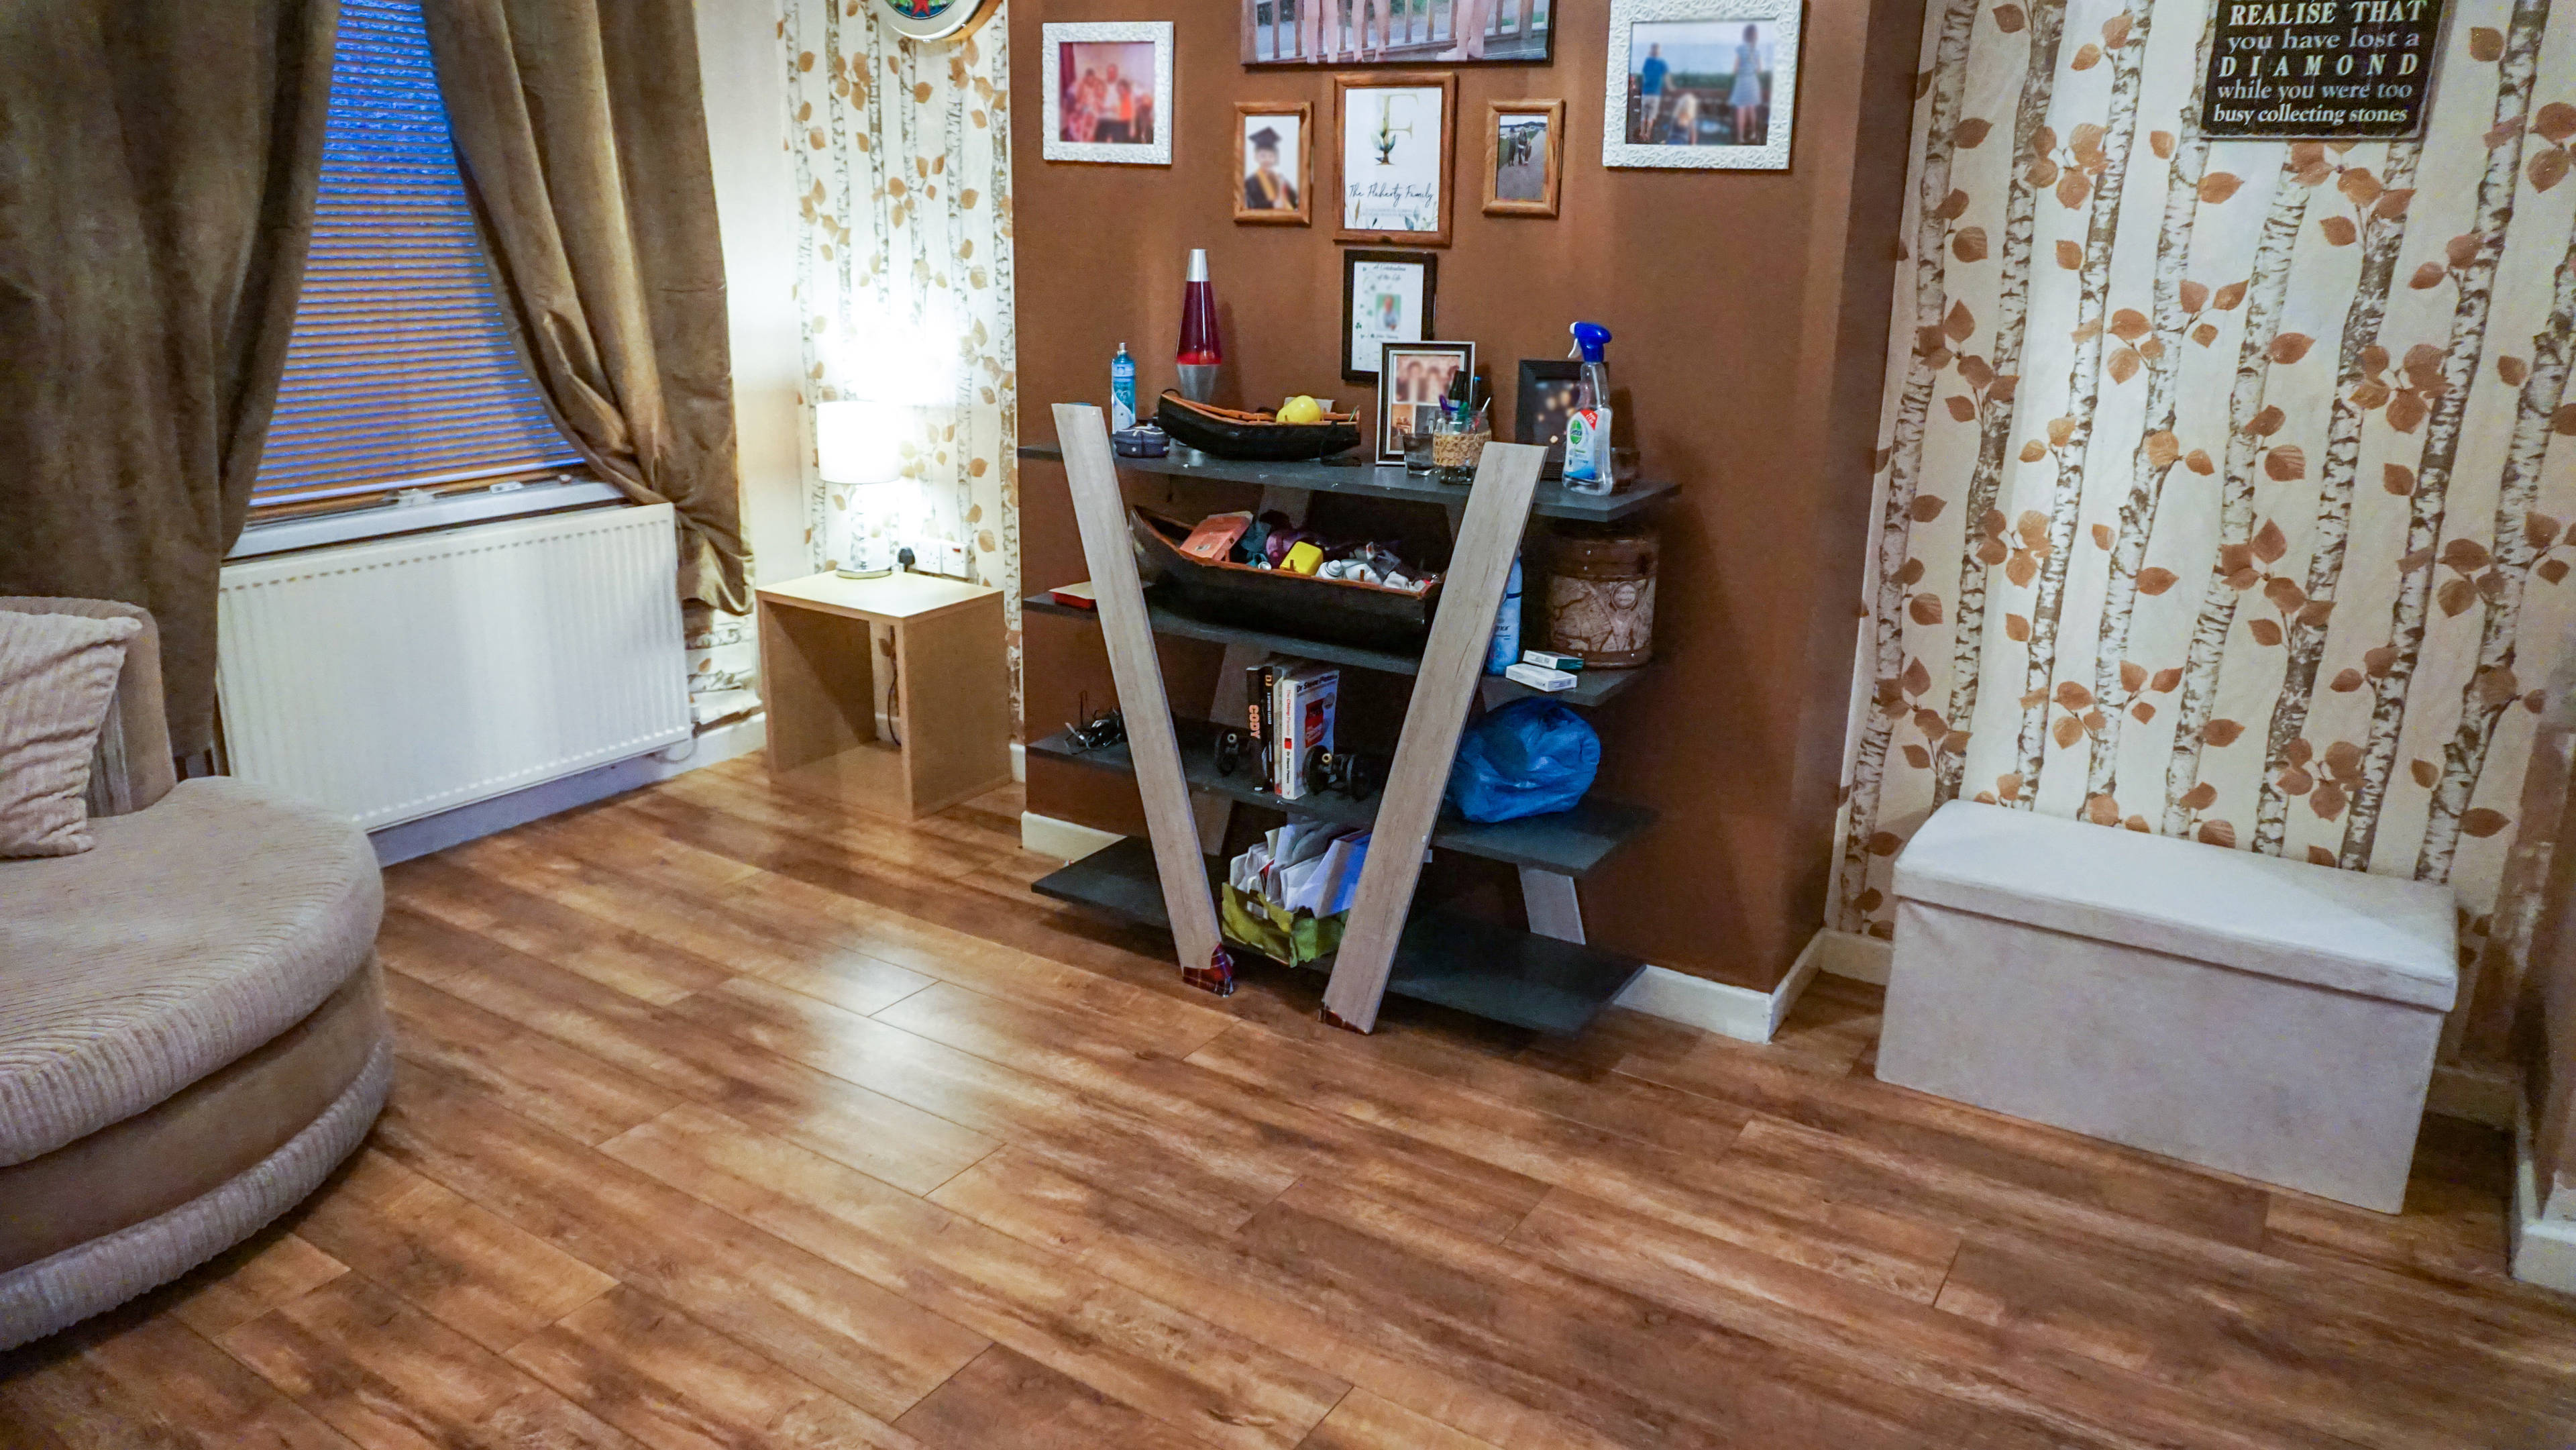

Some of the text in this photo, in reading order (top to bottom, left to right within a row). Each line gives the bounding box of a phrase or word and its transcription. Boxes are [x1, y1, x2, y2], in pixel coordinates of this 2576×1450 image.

[2228, 1, 2427, 26] REALISE THAT
[2228, 27, 2420, 54] you have lost a
[2218, 54, 2419, 78] DIAMOND
[2218, 79, 2413, 103] while you were too
[2213, 103, 2408, 127] busy collecting stones
[1348, 182, 1364, 197] The
[1405, 182, 1434, 208] Family
[1248, 705, 1260, 739] CODY
